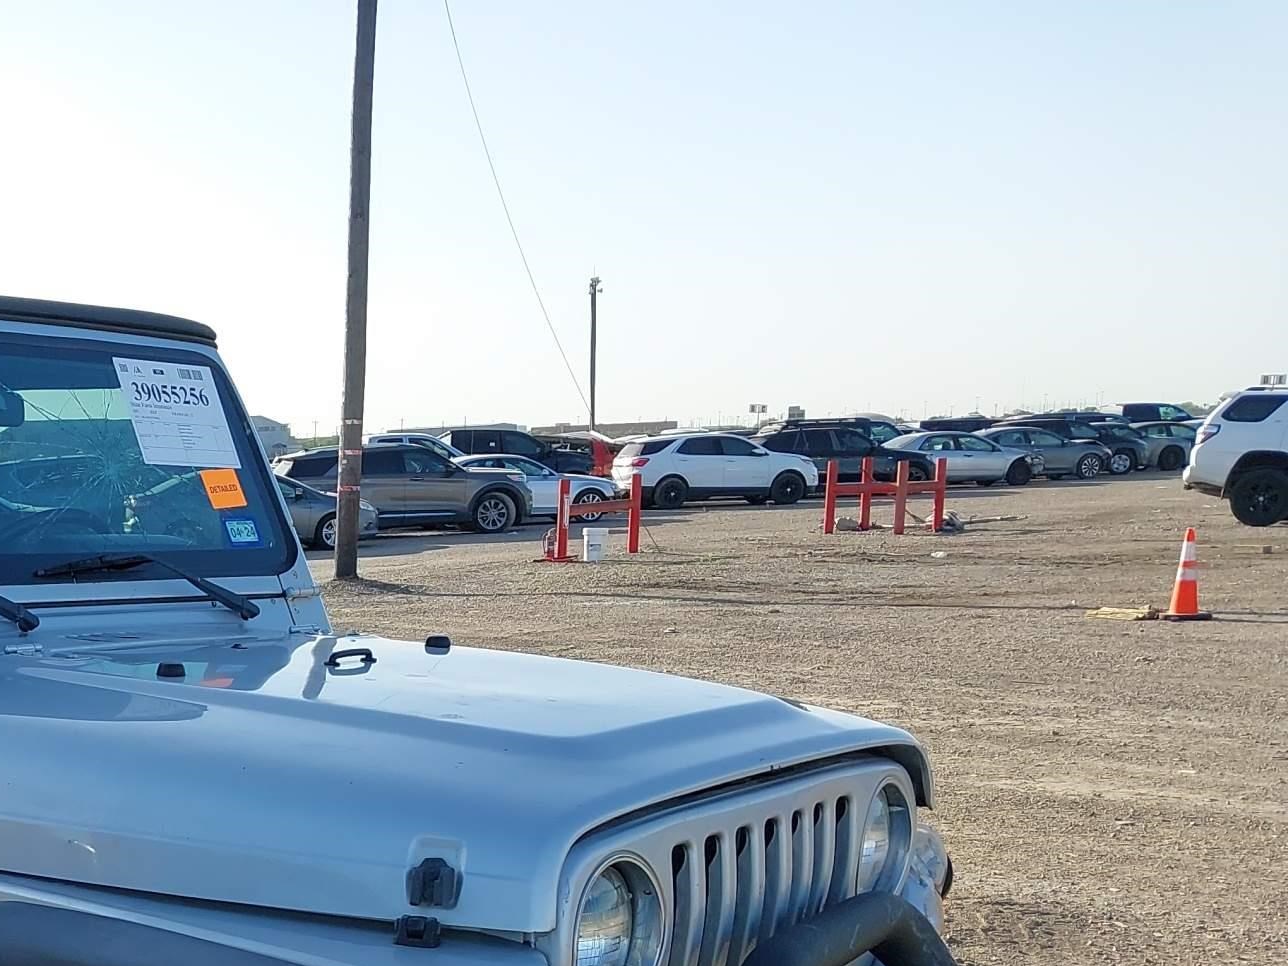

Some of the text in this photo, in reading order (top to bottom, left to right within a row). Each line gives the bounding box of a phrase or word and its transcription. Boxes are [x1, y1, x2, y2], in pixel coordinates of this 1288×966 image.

[130, 381, 210, 407] 39055256
[209, 483, 238, 494] DETAILED
[230, 526, 256, 538] 04 24
